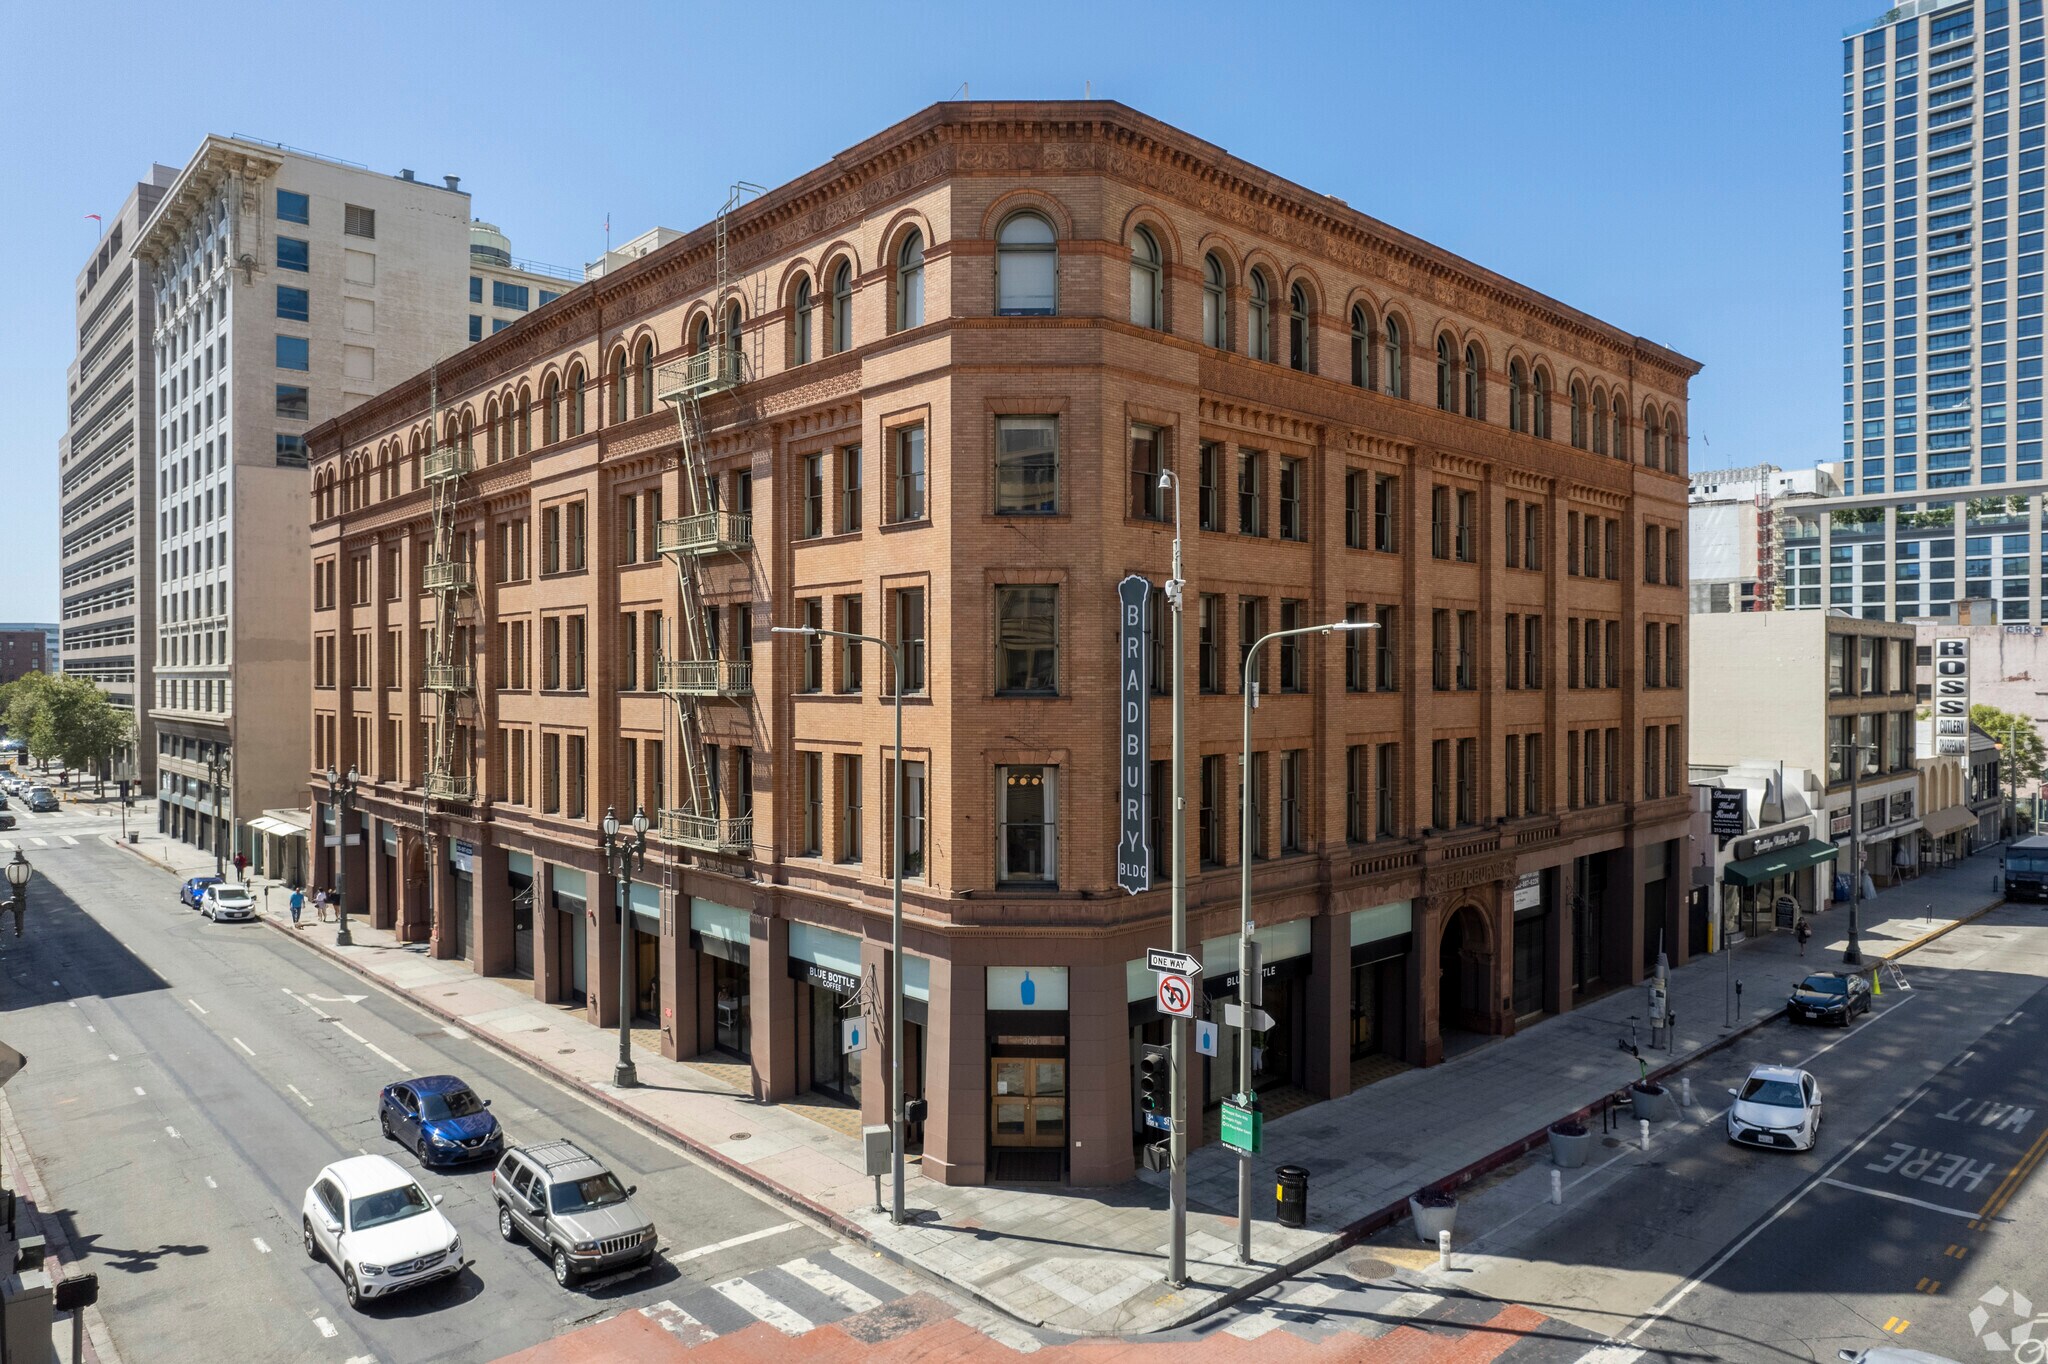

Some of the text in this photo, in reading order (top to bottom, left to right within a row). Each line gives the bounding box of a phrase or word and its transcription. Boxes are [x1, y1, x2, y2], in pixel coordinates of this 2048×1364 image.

[1939, 641, 1965, 714] ROSS
[1127, 604, 1139, 852] BRADBURY
[1939, 719, 1965, 734] CUTLERY
[1939, 738, 1965, 754] SHARPENING
[1120, 863, 1146, 879] BLDG
[1447, 864, 1495, 889] BRADBURY
[1152, 956, 1185, 969] ONE WAY
[809, 966, 855, 988] BLUE BOTTLE
[822, 980, 842, 992] COFFEE
[1226, 975, 1240, 987] BLU
[1935, 1098, 2036, 1134] WAIT
[1864, 1142, 1996, 1193] HERE
